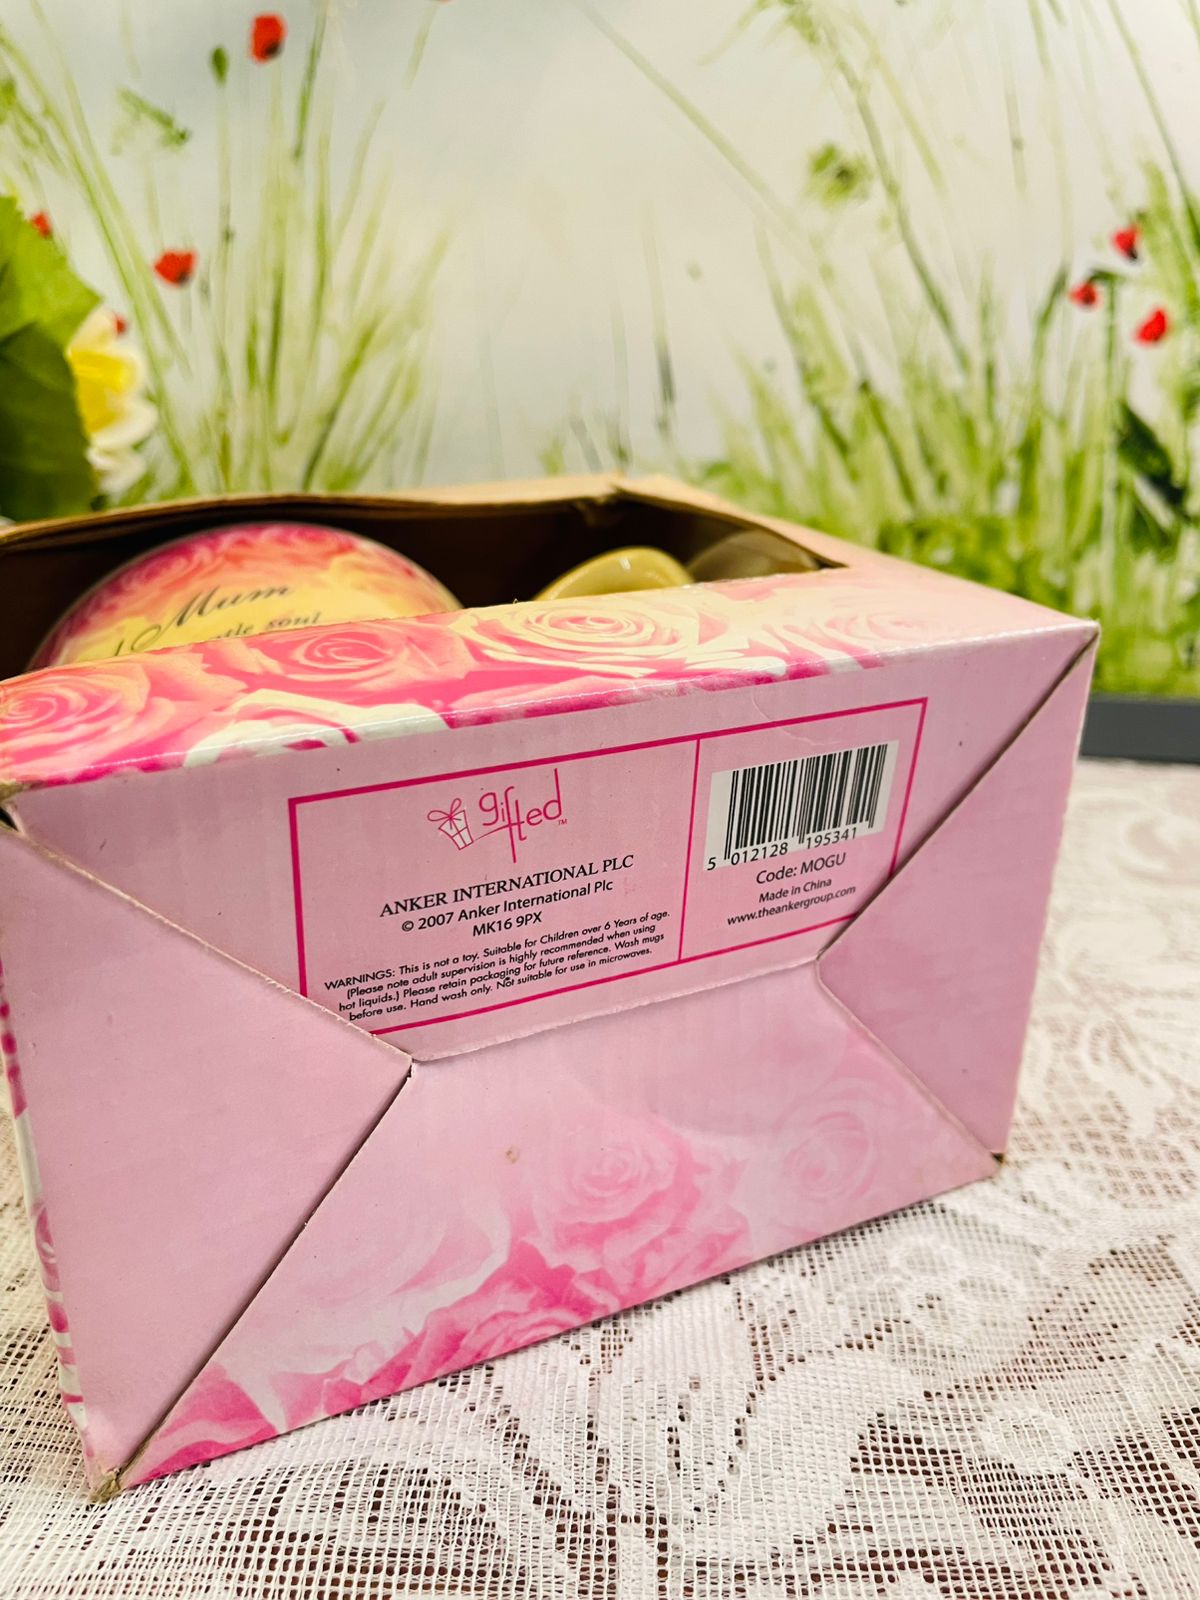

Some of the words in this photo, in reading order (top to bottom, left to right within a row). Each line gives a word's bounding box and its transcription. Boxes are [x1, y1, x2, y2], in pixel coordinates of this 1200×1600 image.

[131, 585, 291, 650] Mum
[265, 611, 322, 630] soul
[479, 768, 562, 863] gifted
[707, 857, 717, 871] 5
[730, 842, 789, 866] 012128
[806, 827, 857, 849] 195341
[756, 866, 798, 884] Code:
[800, 852, 847, 875] MOGU
[380, 892, 448, 917] ANKER
[453, 862, 598, 903] INTERNATIONAL
[602, 854, 634, 873] PLC
[418, 912, 454, 930] 2007
[458, 905, 501, 921] Anker
[503, 883, 590, 912] International
[594, 880, 613, 893] Plc
[727, 886, 856, 925] www.theankergroup.com
[758, 888, 789, 903] Made
[791, 885, 801, 895] in
[803, 878, 832, 892] China
[324, 968, 396, 990] WARNINGS:
[399, 965, 419, 975] This
[422, 962, 431, 970] is
[434, 958, 449, 968] not
[462, 952, 479, 962] toy.
[483, 942, 521, 957] Suitable
[524, 939, 537, 948] for
[540, 931, 579, 944] Children
[582, 925, 601, 935] over
[604, 921, 611, 930] 6
[613, 918, 637, 928] Years
[639, 912, 649, 922] of
[650, 911, 670, 921] age.
[472, 918, 512, 936] MK16
[516, 911, 542, 927] 9PX
[339, 1001, 356, 1011] hot
[358, 991, 400, 1008] liquids.)
[403, 984, 435, 998] Please
[438, 977, 467, 991] retain
[470, 966, 521, 986] packaging
[523, 962, 536, 972] for
[539, 956, 565, 968] future
[567, 946, 611, 961] reference.
[614, 937, 639, 950] Wash
[642, 934, 664, 944] mugs
[347, 985, 384, 1000] (Please
[387, 978, 409, 989] note
[412, 971, 438, 984] adult
[441, 961, 496, 978] supervision
[499, 957, 506, 966] is
[509, 950, 538, 964] highly
[540, 933, 604, 956] recommended
[607, 930, 630, 941] when
[633, 924, 656, 935] using
[349, 1008, 383, 1021] before
[386, 1004, 406, 1013] use.
[410, 994, 438, 1008] Hand
[441, 989, 467, 1002] wash
[470, 984, 493, 995] only.
[496, 979, 515, 989] Not
[517, 969, 552, 985] suitable
[555, 965, 567, 975] for
[570, 962, 585, 972] use
[588, 959, 596, 967] in
[599, 948, 652, 965] microwaves.
